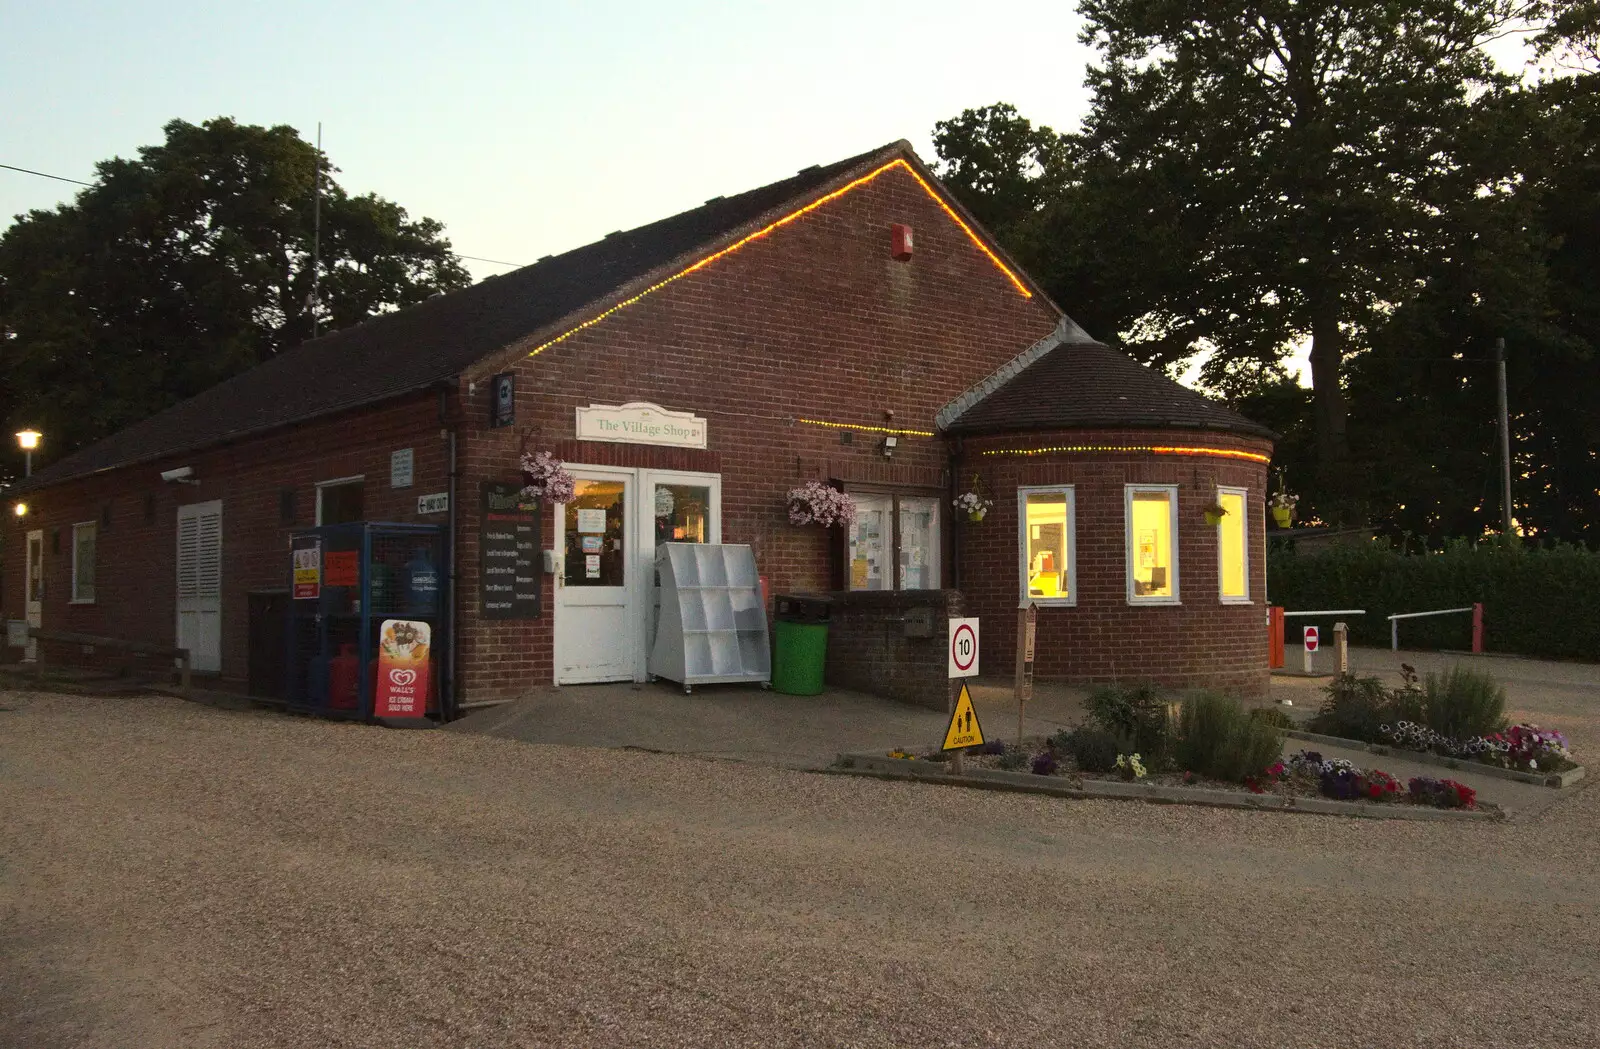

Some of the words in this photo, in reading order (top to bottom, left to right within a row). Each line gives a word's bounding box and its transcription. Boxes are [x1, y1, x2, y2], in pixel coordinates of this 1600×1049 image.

[596, 419, 619, 431] The
[622, 421, 661, 437] Village
[663, 424, 690, 439] Shop
[426, 499, 436, 511] WAY
[437, 497, 447, 509] OUT
[959, 639, 969, 655] 10
[390, 686, 415, 694] WALL'S
[388, 696, 397, 704] ICE
[397, 696, 414, 704] CREAM
[388, 704, 400, 712] SOLD
[401, 704, 414, 712] HERE
[953, 735, 975, 744] CAUTION
